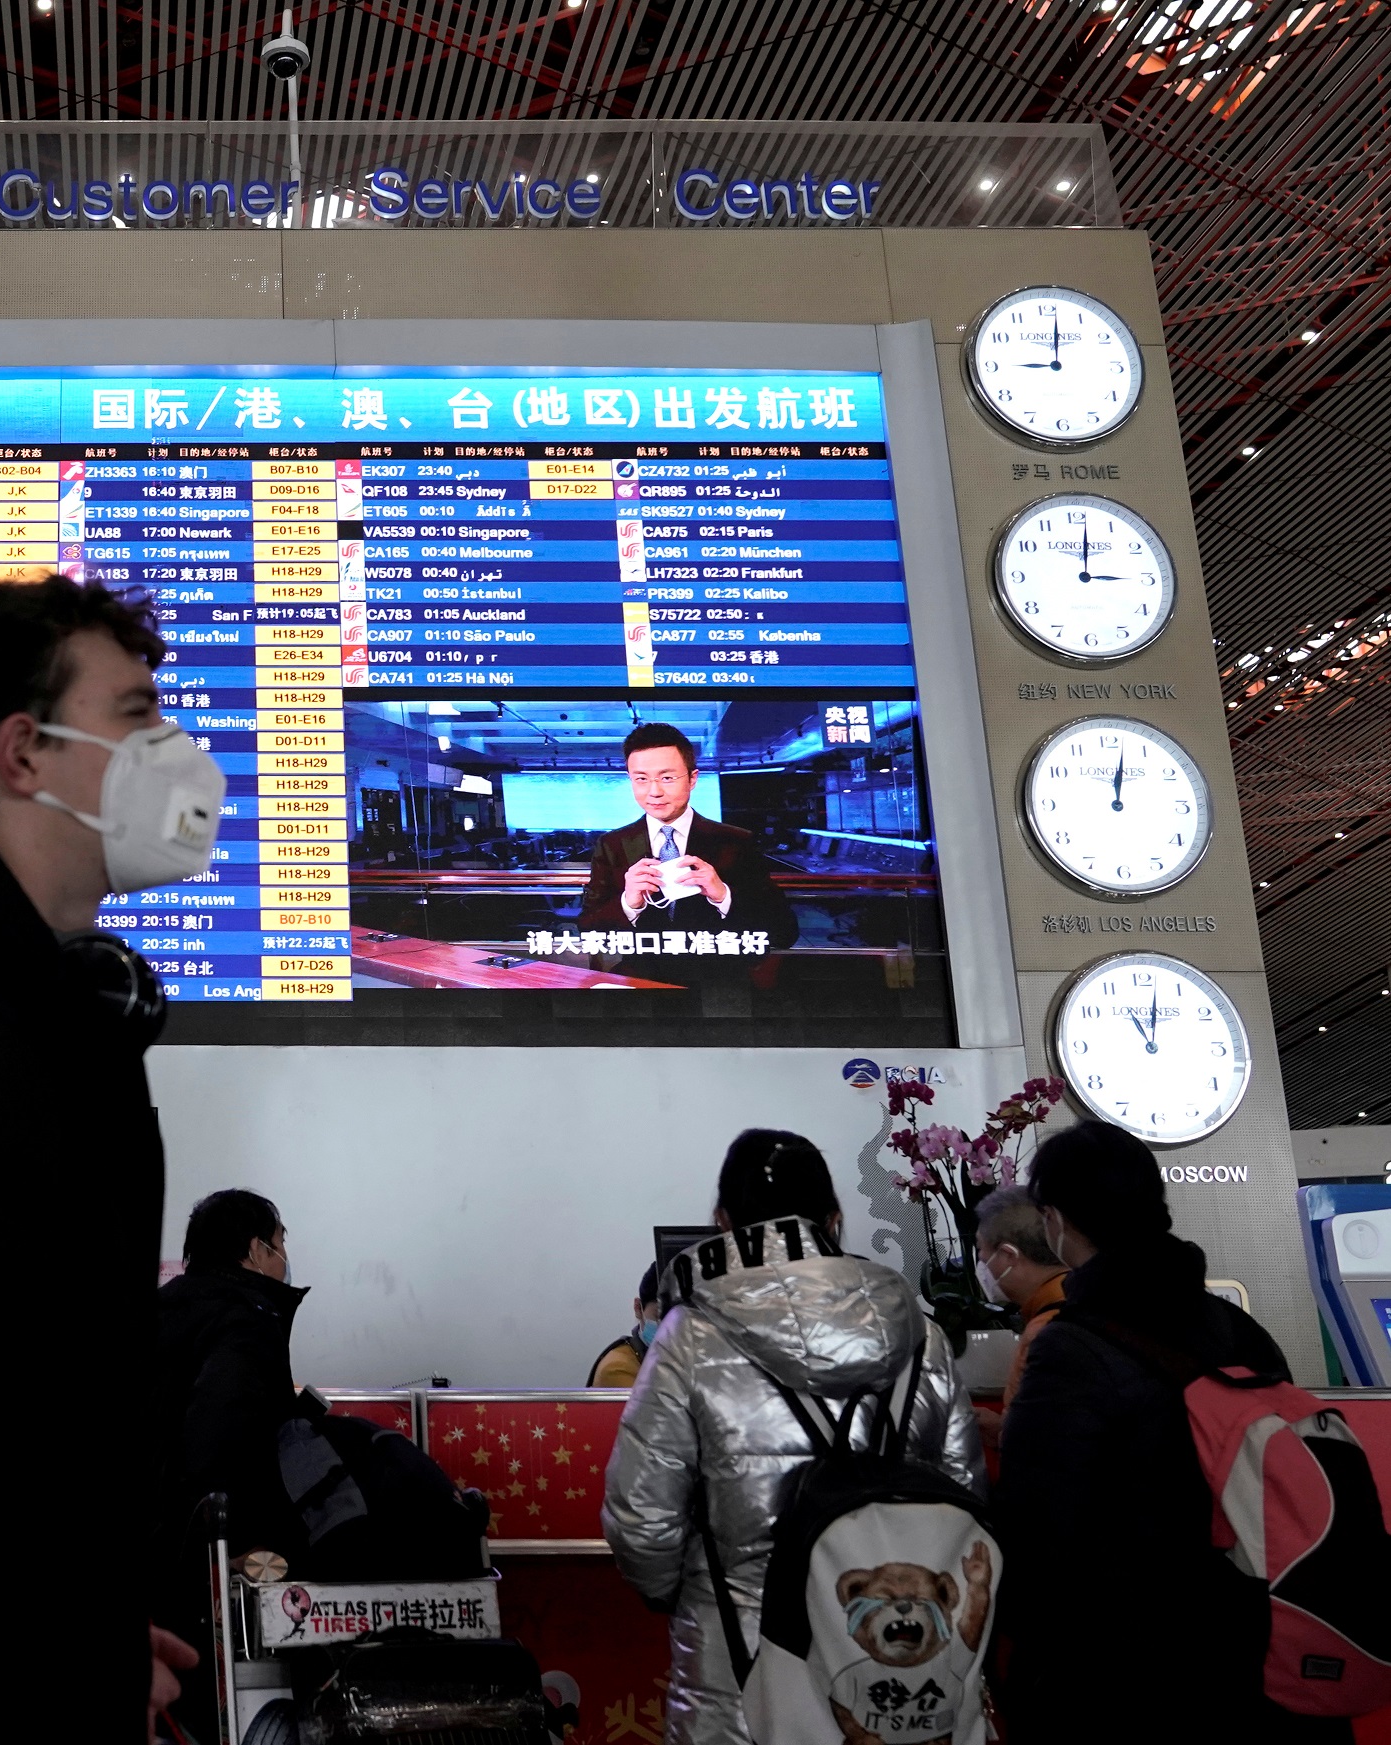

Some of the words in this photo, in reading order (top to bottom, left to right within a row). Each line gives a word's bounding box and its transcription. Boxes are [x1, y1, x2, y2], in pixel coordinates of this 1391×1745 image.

[369, 167, 601, 222] Service
[673, 168, 881, 222] Center
[85, 448, 116, 457] 航班号
[148, 448, 168, 458] 计划
[180, 448, 249, 457] 目的地/经停站
[269, 448, 317, 457] 柜台/状态
[85, 466, 136, 478] ZH3363
[143, 467, 176, 476] 16:10
[179, 466, 207, 479] 澳门
[270, 465, 319, 475] B07-B10
[1012, 464, 1050, 480] 罗马
[1060, 465, 1120, 480] ROME
[362, 486, 408, 496] QF108
[419, 486, 453, 495] 23:45
[457, 486, 506, 500] Sydney
[547, 484, 597, 494] D17-D22
[85, 507, 137, 518] ET1339
[143, 507, 176, 516] 16:40
[179, 507, 249, 521] Singapore
[271, 505, 319, 515] F04-F18
[642, 506, 693, 517] SK9527
[698, 506, 733, 516] 01:40
[736, 506, 785, 520] Sydney
[85, 527, 121, 538] UA88
[143, 527, 176, 537] 17:00
[180, 527, 232, 538] Newark
[271, 525, 321, 535] E01-E16
[643, 527, 688, 538] CA875
[700, 526, 735, 536] 02:15
[738, 526, 773, 537] Paris
[364, 548, 409, 558] CA165
[422, 547, 456, 556] 00:40
[460, 547, 533, 558] Melbourne
[647, 568, 698, 578] LH7323
[703, 568, 738, 577] 02:20
[742, 568, 803, 578] Frankfurt
[367, 630, 412, 642] CA907
[425, 630, 460, 640] 01:10
[464, 630, 491, 641] São
[495, 630, 535, 641] Paulo
[1019, 683, 1057, 700] 纽约
[1068, 684, 1111, 699] NEW
[1120, 684, 1177, 699] YORK
[824, 705, 868, 725] 央视
[825, 725, 871, 743] 新闻
[1043, 915, 1093, 933] 洛杉矶
[1099, 916, 1134, 932] LOS
[1140, 916, 1217, 932] ANGELES
[526, 930, 769, 956] 请大家把口罩准备好
[310, 1601, 367, 1617] ATLAS
[372, 1598, 484, 1632] 阿特拉斯
[310, 1617, 370, 1633] TIRES
[907, 1714, 933, 1730] ME
